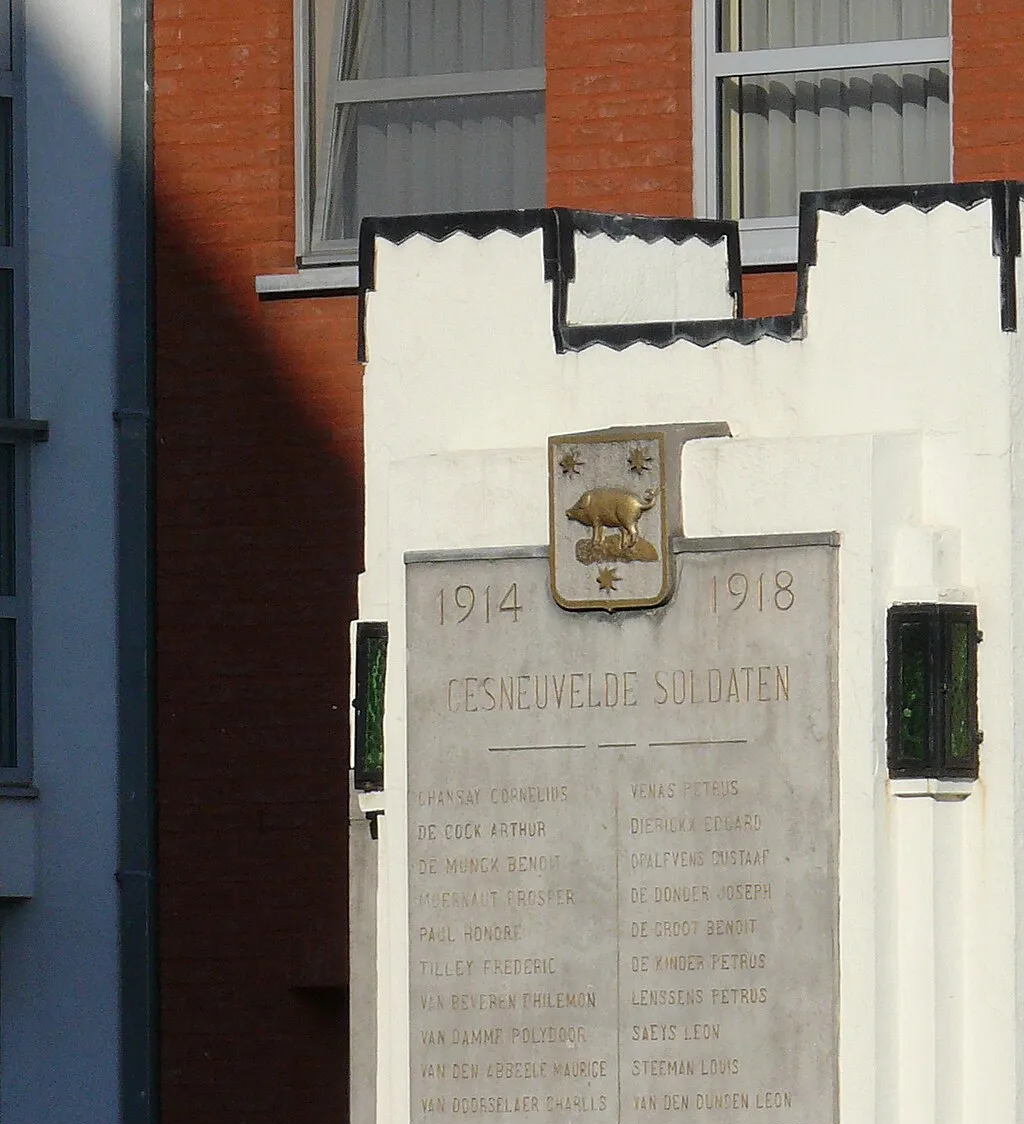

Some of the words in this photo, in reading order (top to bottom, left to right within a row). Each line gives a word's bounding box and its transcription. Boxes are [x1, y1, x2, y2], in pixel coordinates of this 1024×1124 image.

[709, 569, 795, 615] 1918
[436, 581, 522, 626] 1914
[447, 671, 637, 713] GESNEUVELDE
[654, 665, 790, 706] SOLDATEN
[491, 786, 568, 804] CORNELIUS
[631, 782, 676, 799] VENAS
[684, 780, 739, 798] PETRUS
[418, 824, 436, 840] DE
[445, 823, 481, 840] COCK
[491, 821, 546, 838] ARTHUR
[419, 858, 437, 875] DE
[508, 855, 560, 872] BENOIT
[712, 849, 769, 867] GUSTAAF
[507, 889, 575, 907] PROSPER
[631, 887, 647, 903] DE
[655, 885, 710, 903] DONDER
[717, 883, 772, 901] JOSEPH
[419, 926, 455, 942] PAUL
[631, 922, 648, 938] DE
[655, 920, 699, 937] GROOT
[707, 918, 756, 936] BENOIT
[420, 959, 473, 976] TILLEY
[483, 957, 556, 975] FREDERIC
[631, 956, 649, 972] DE
[655, 954, 704, 971] KINDER
[711, 953, 766, 971] PETRUS
[451, 994, 516, 1011] BEVEREN
[523, 992, 597, 1009] PHILEMON
[631, 989, 704, 1006] LENSSENS
[711, 988, 768, 1005] PETRUS
[420, 1029, 445, 1045] VAN
[452, 1028, 503, 1045] DAMME
[512, 1026, 587, 1044] POLYDOOR
[632, 1025, 677, 1041] SAEYS
[684, 1024, 720, 1040] LEON
[421, 1063, 445, 1079] VAN
[452, 1063, 478, 1079] DEN
[487, 1062, 547, 1079] ABBEELE
[553, 1060, 607, 1078] MAURICE
[632, 1060, 694, 1076] STEEMAN
[701, 1059, 739, 1076] LOUIS
[421, 1098, 445, 1114] VAN
[452, 1096, 539, 1113] DOORSELAER
[546, 1095, 607, 1112] CHARLES
[633, 1096, 656, 1111] VAN
[664, 1095, 689, 1111] DEN
[756, 1092, 792, 1109] LEON
